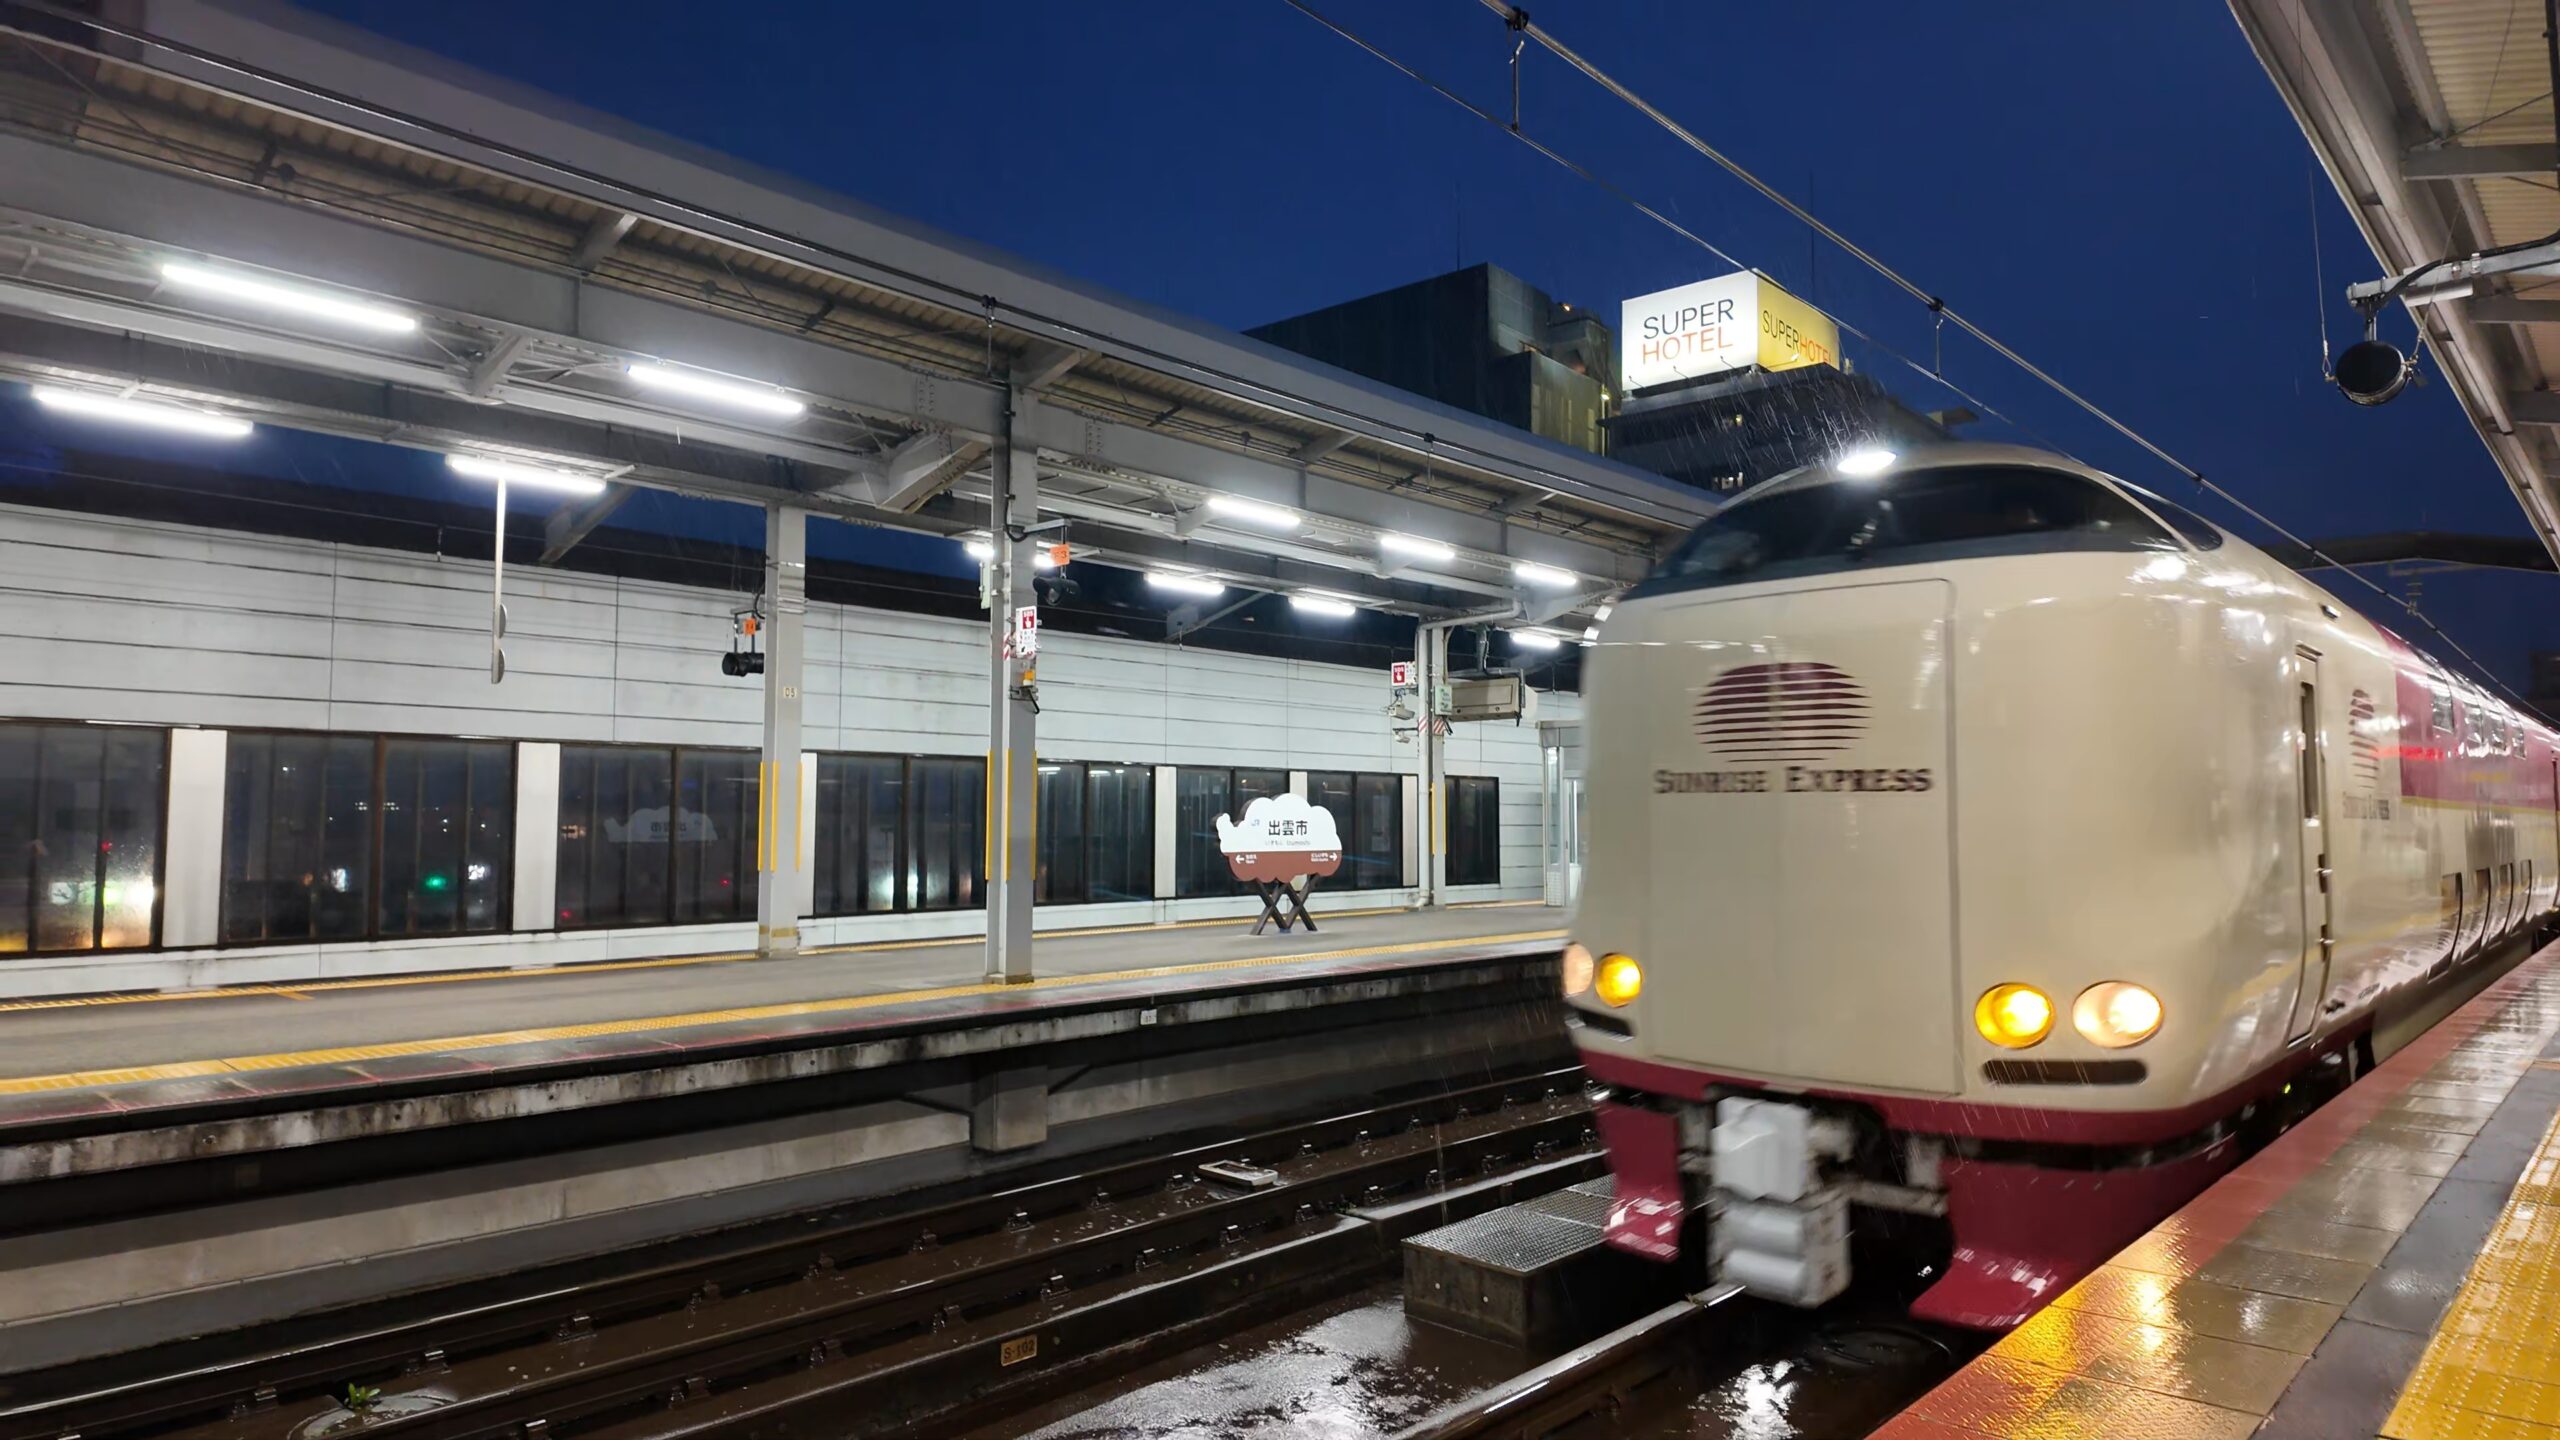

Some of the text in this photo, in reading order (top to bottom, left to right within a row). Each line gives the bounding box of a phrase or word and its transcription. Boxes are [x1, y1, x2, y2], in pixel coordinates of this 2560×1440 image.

[1643, 298, 1734, 340] SUPER
[1643, 326, 1733, 364] HOTEL
[1784, 765, 1934, 793] EXPRESS
[1268, 819, 1308, 837] 出雲市
